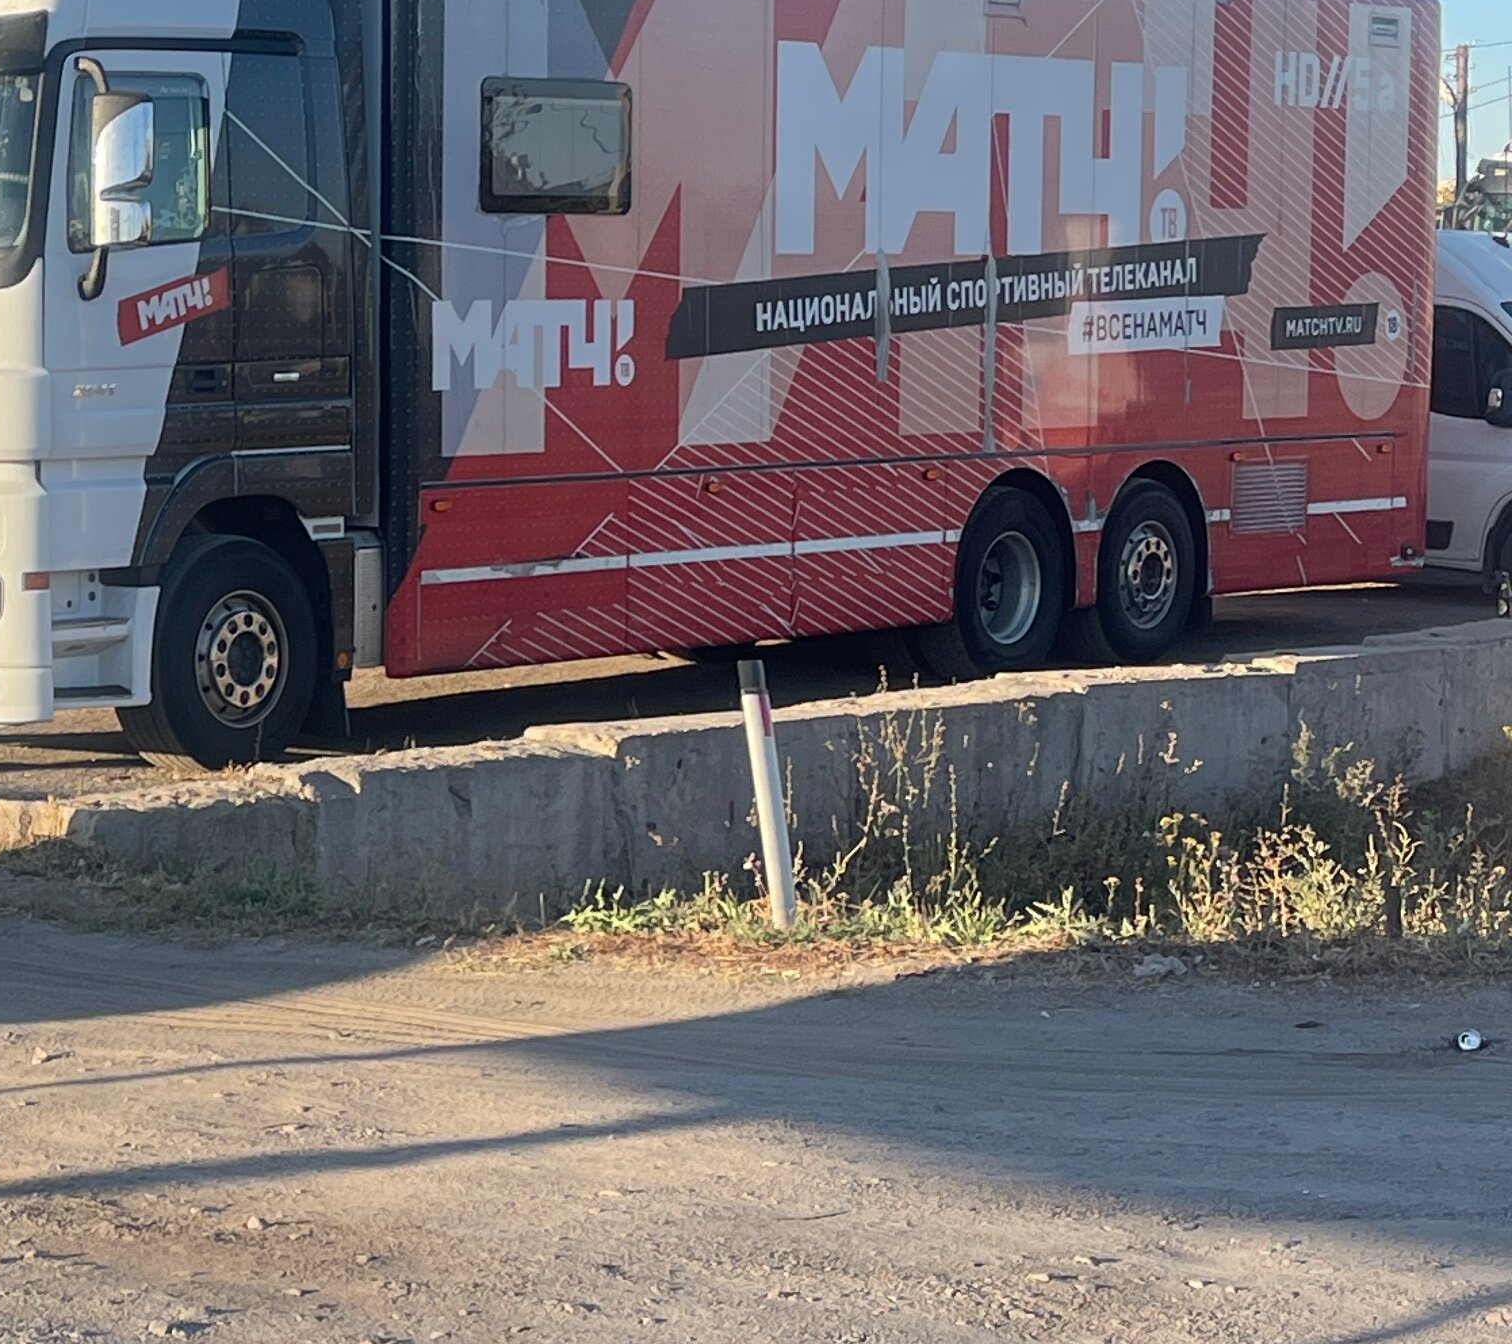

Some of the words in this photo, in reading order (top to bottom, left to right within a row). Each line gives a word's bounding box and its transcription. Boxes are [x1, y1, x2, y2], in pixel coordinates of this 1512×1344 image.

[775, 39, 1188, 257] МАТЧ!
[136, 277, 214, 332] МАТЧ!
[755, 276, 942, 332] НАЦИОНАЛНЫЙ
[1088, 257, 1197, 294] ТЕЛЕКАНАЛ
[1082, 309, 1208, 343] #ВСЕНАМАТЧ
[1285, 316, 1363, 338] MATCHTV.RU
[431, 298, 636, 391] МАТЧ!
